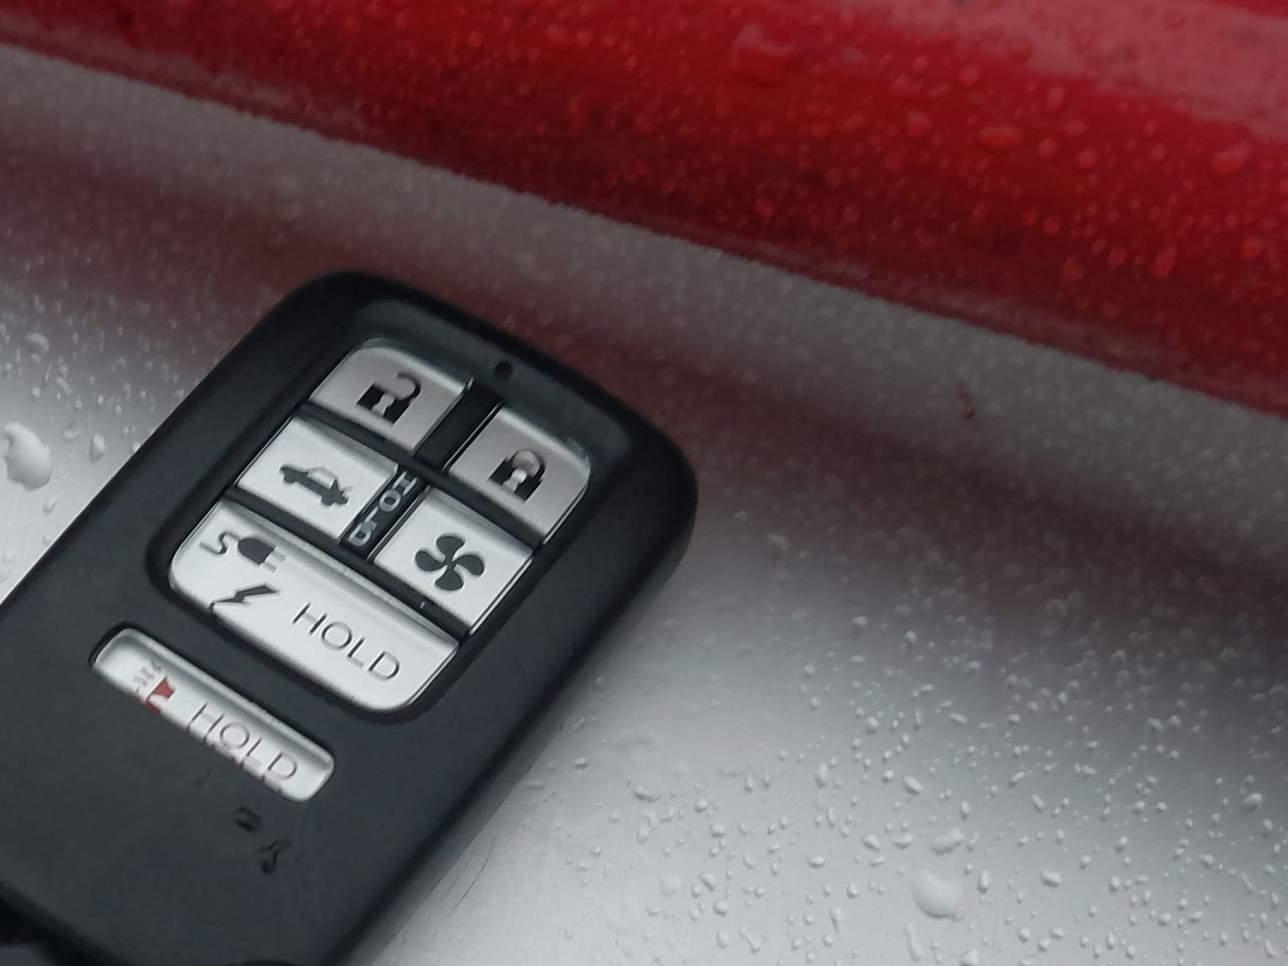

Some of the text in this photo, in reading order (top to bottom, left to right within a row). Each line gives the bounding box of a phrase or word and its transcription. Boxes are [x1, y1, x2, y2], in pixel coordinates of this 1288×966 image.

[348, 471, 418, 546] HOLD
[291, 602, 401, 683] HOLD
[190, 702, 298, 780] HOLD
